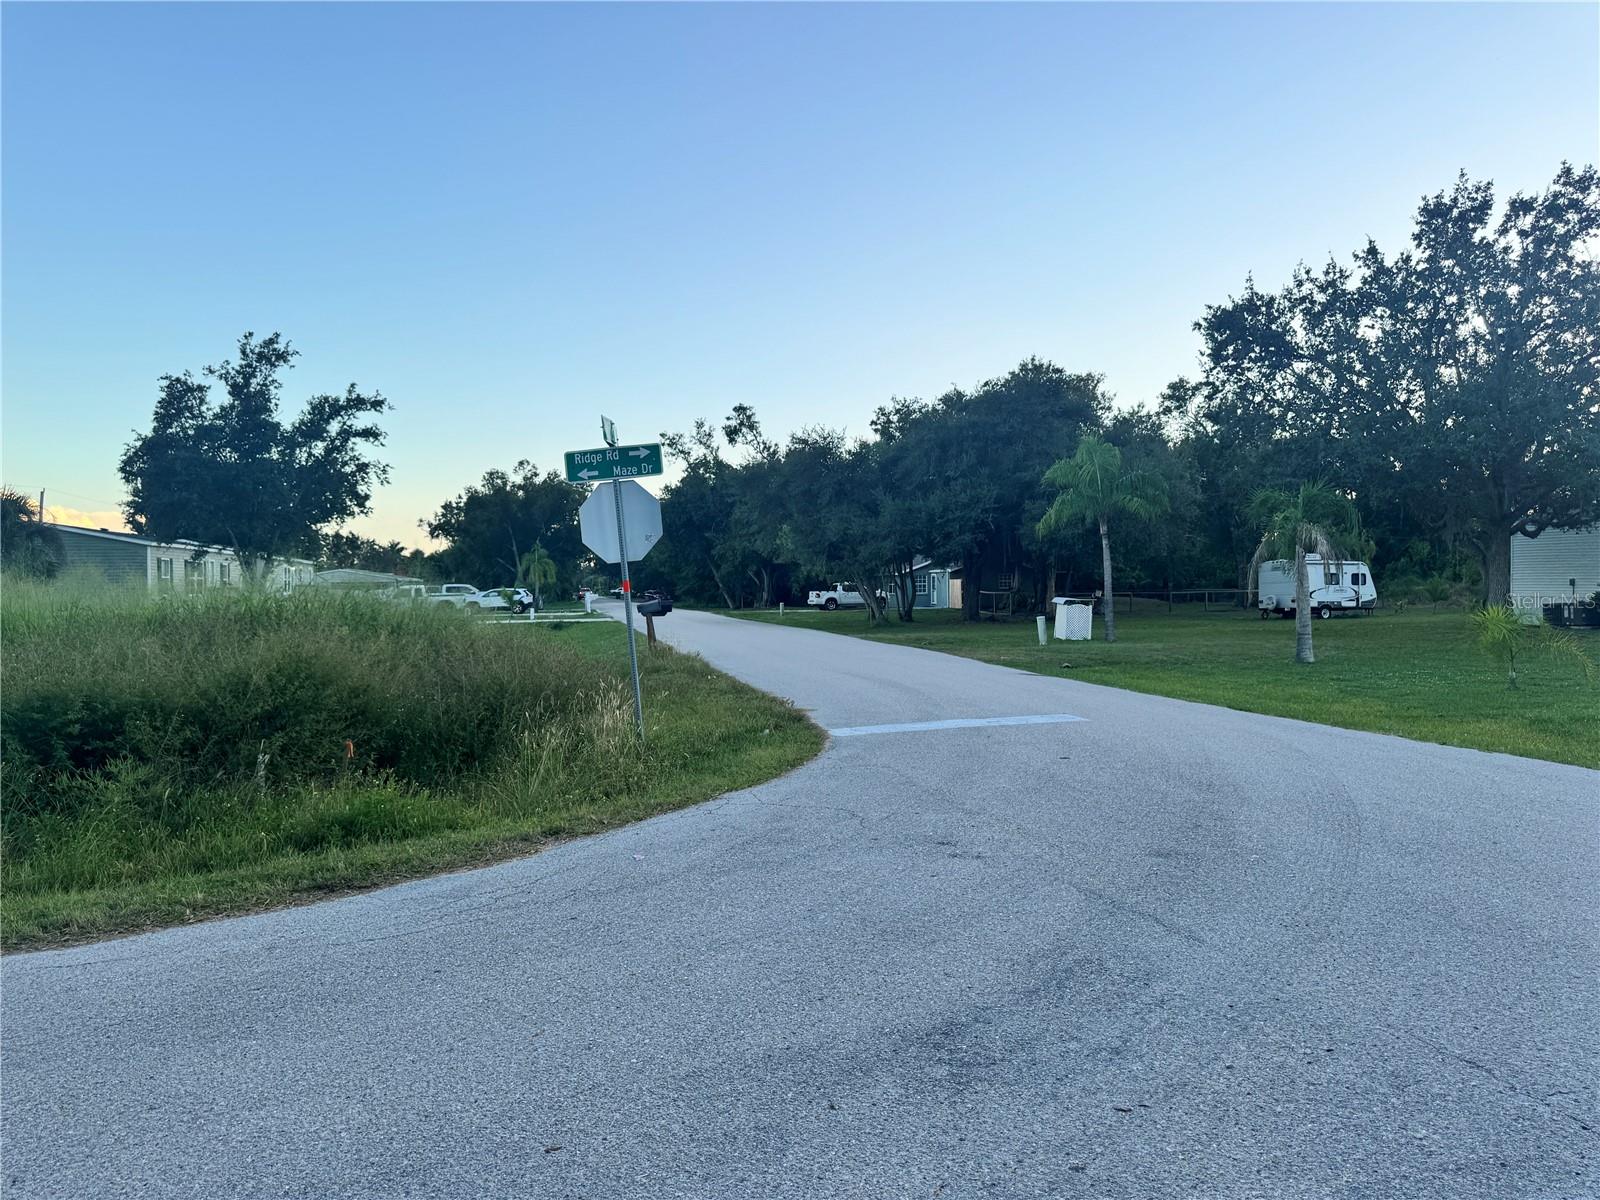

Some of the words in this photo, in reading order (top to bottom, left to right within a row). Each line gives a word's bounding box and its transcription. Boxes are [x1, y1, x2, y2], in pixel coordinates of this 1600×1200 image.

[575, 452, 602, 465] Ridge
[606, 450, 619, 460] Rd
[613, 465, 638, 476] Maze
[641, 463, 653, 473] Dr
